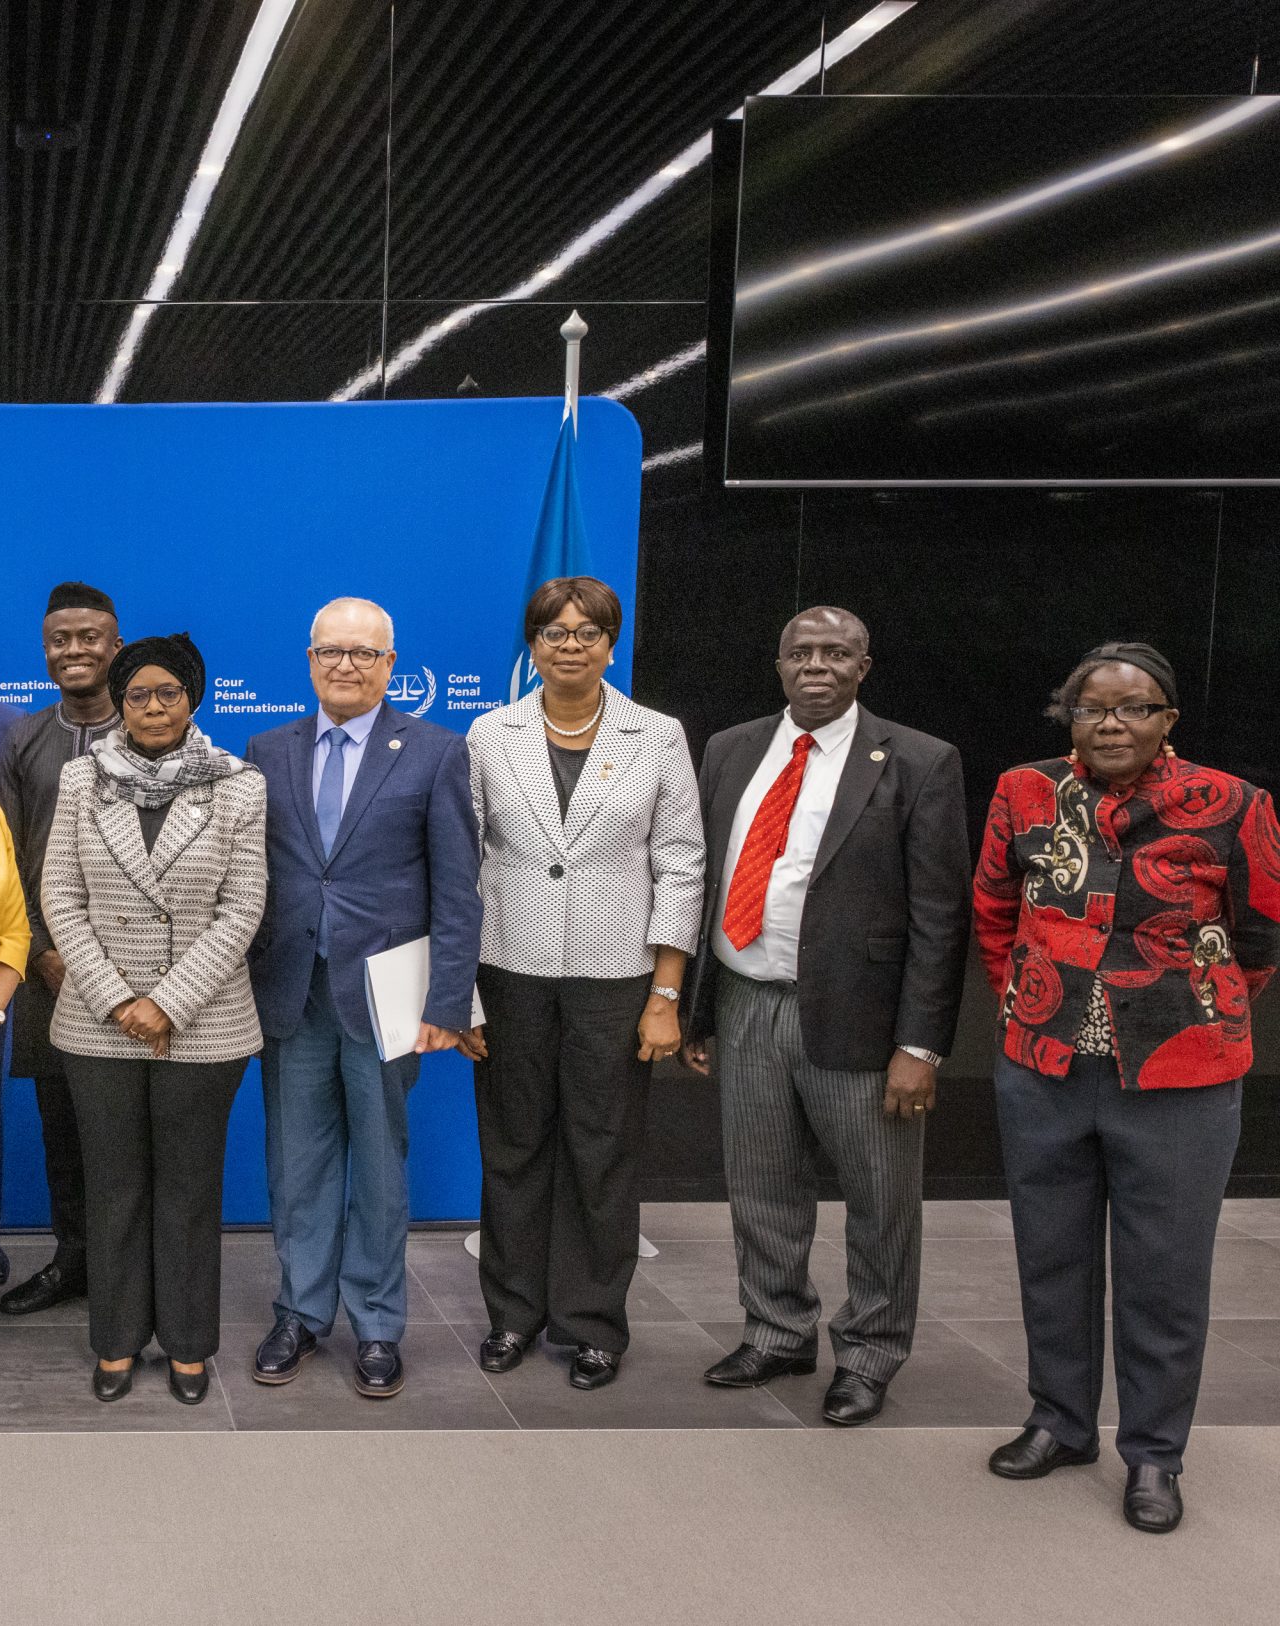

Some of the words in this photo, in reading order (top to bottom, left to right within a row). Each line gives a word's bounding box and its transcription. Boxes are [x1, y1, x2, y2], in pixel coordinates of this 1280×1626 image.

[214, 678, 244, 687] Cour
[448, 674, 481, 684] Corte
[214, 690, 257, 700] Pénale
[447, 686, 481, 697] Penal
[214, 702, 306, 714] Internationale
[447, 700, 504, 710] Internaci
